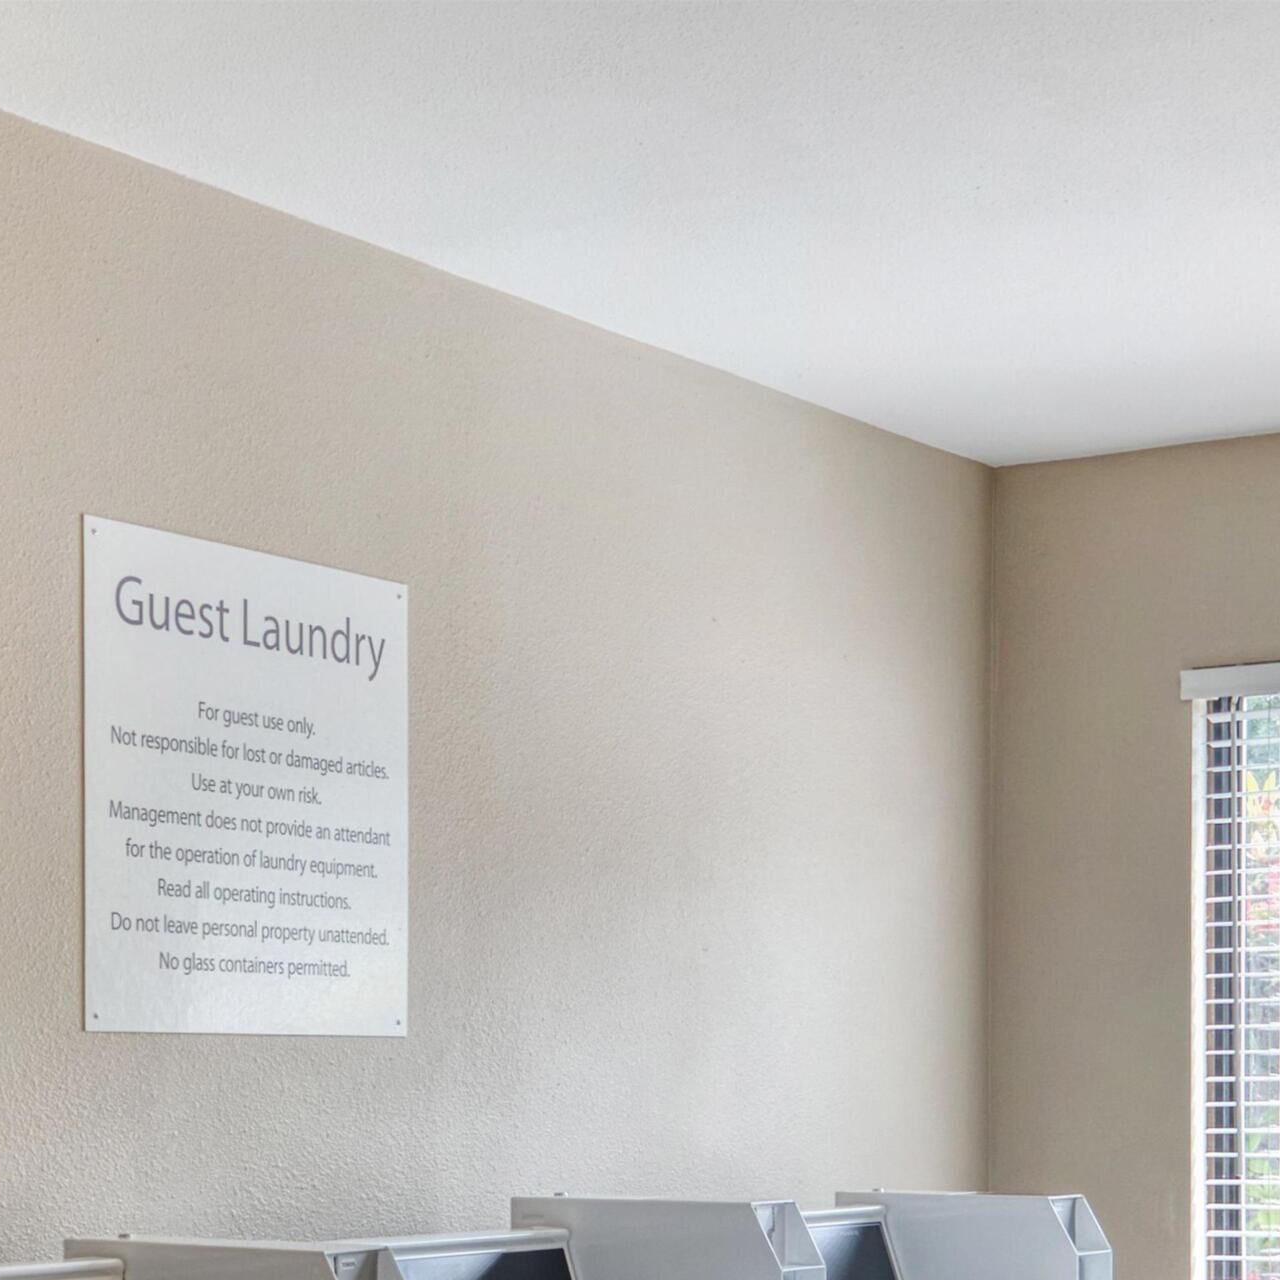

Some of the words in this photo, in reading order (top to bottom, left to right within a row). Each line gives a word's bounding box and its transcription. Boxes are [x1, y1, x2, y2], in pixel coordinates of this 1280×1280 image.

[115, 575, 230, 642] Guest
[243, 599, 385, 682] Laundry
[198, 702, 219, 721] For
[223, 707, 258, 730] guest
[263, 715, 284, 731] use
[287, 717, 316, 740] only.
[111, 725, 137, 748] Not
[141, 732, 218, 758] responsible
[221, 740, 239, 760] for
[243, 744, 266, 764] lost
[270, 750, 282, 765] or
[286, 750, 343, 776] damaged
[346, 761, 390, 780] articles.
[192, 772, 216, 793] Use
[219, 779, 232, 795] at
[235, 782, 264, 800] your
[268, 786, 295, 802] own
[298, 787, 322, 805] risk.
[109, 800, 202, 828] Management
[205, 810, 237, 831] does
[241, 818, 262, 834] not
[266, 820, 313, 838] provide
[316, 826, 331, 840] an
[334, 828, 391, 846] attendant
[126, 838, 145, 858] for
[149, 841, 171, 860] the
[176, 845, 240, 866] operation
[243, 850, 256, 868] of
[260, 852, 306, 876] laundry
[309, 859, 377, 879] equipment.
[158, 878, 191, 898] Read
[195, 881, 210, 900] all
[214, 885, 275, 909] operating
[279, 888, 351, 910] instructions.
[111, 912, 132, 931] Do
[136, 915, 160, 933] not
[163, 915, 198, 935] leave
[202, 921, 257, 944] personal
[261, 926, 315, 946] property
[319, 928, 390, 946] unattended.
[160, 952, 179, 970] No
[183, 953, 215, 975] glass
[219, 956, 284, 975] containers
[288, 960, 350, 979] permitted.
